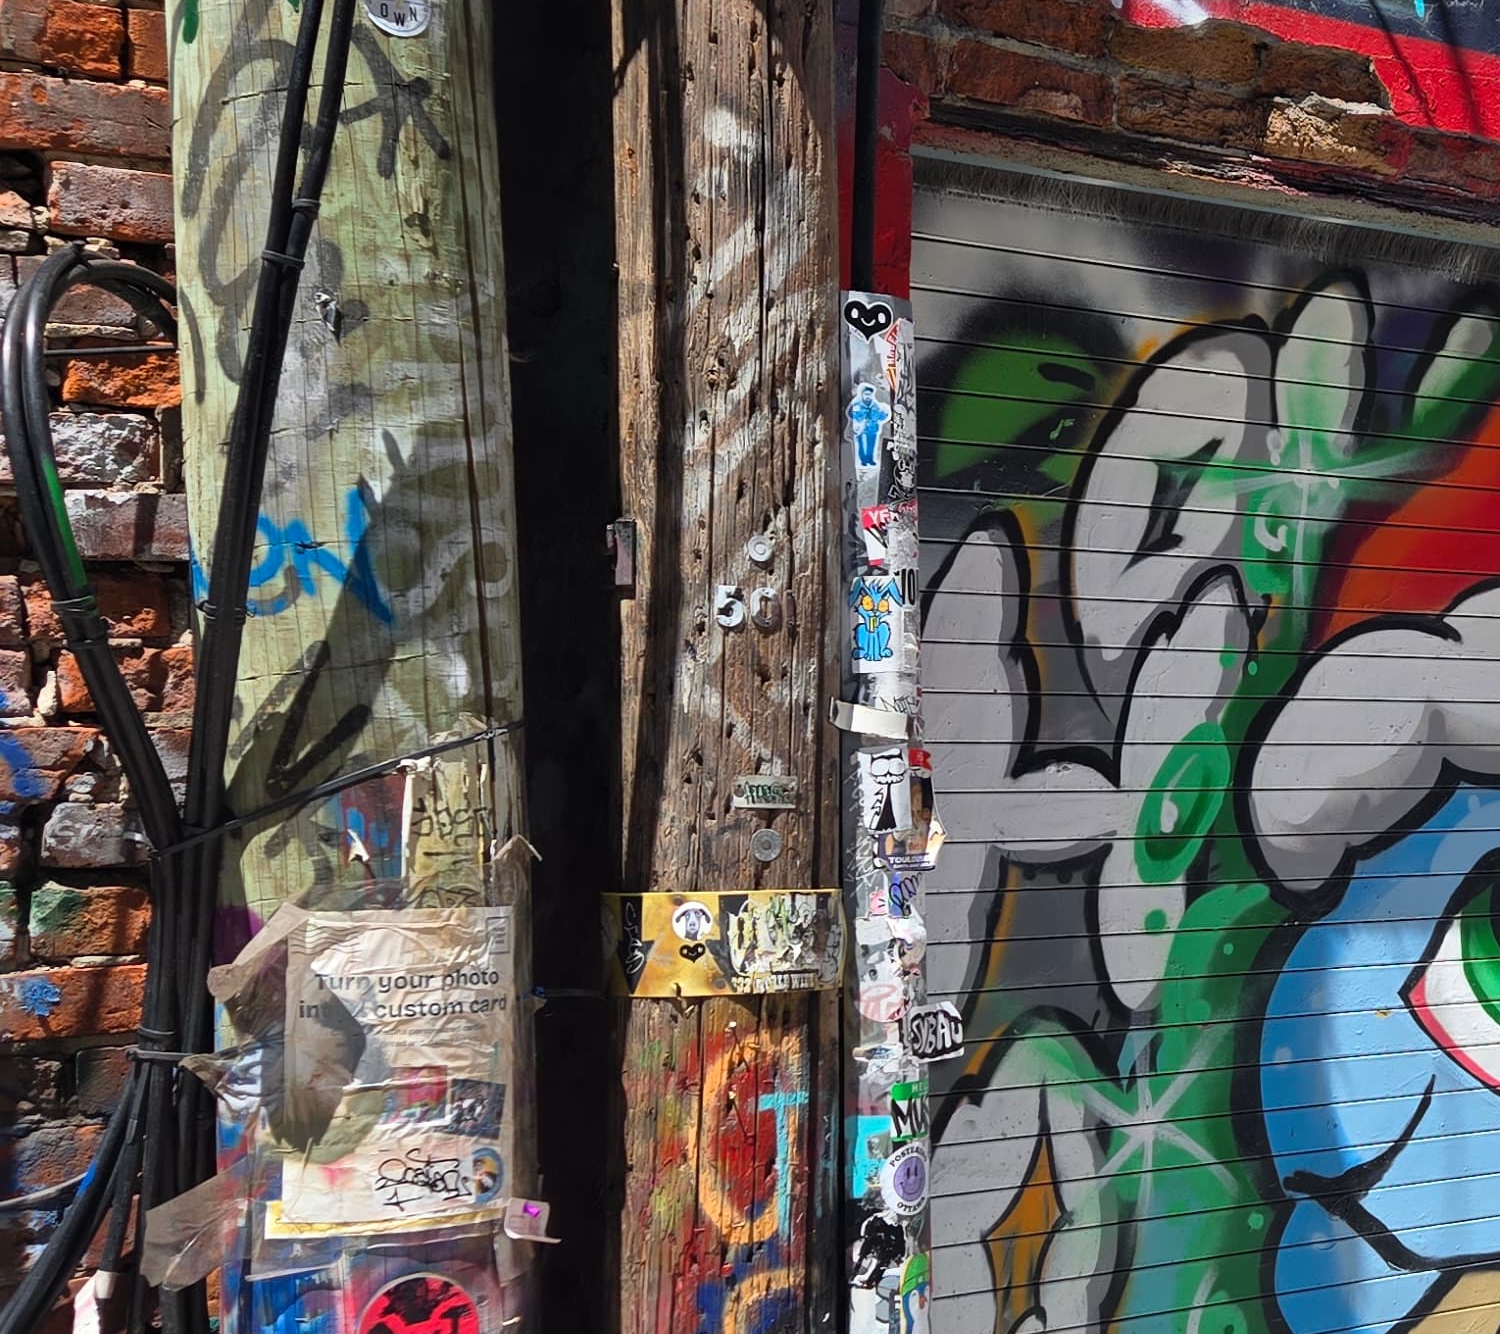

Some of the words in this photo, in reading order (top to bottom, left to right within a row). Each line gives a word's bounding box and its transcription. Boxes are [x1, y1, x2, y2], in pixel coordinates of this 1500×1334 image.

[313, 973, 371, 991] Turn
[378, 974, 438, 994] your
[441, 968, 500, 992] photo
[375, 1001, 463, 1019] custom
[469, 994, 508, 1013] card
